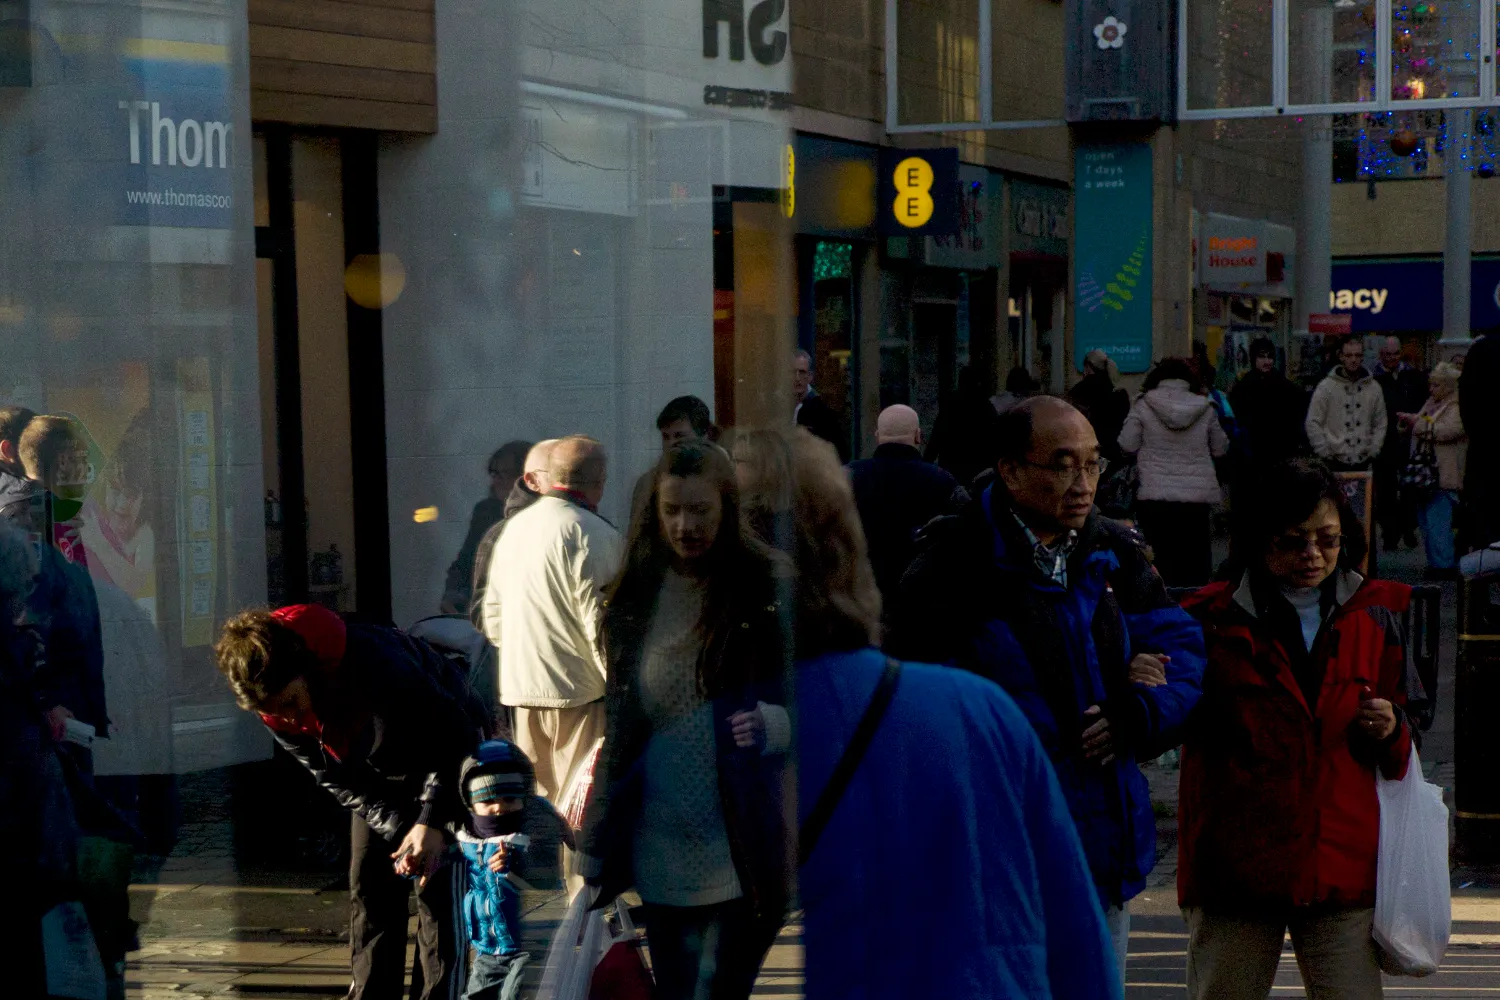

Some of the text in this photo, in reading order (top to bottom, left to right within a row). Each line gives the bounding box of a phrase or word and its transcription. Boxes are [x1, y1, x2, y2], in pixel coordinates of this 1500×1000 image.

[118, 100, 235, 169] Thom
[1208, 236, 1258, 252] Bright
[1208, 255, 1257, 268] House
